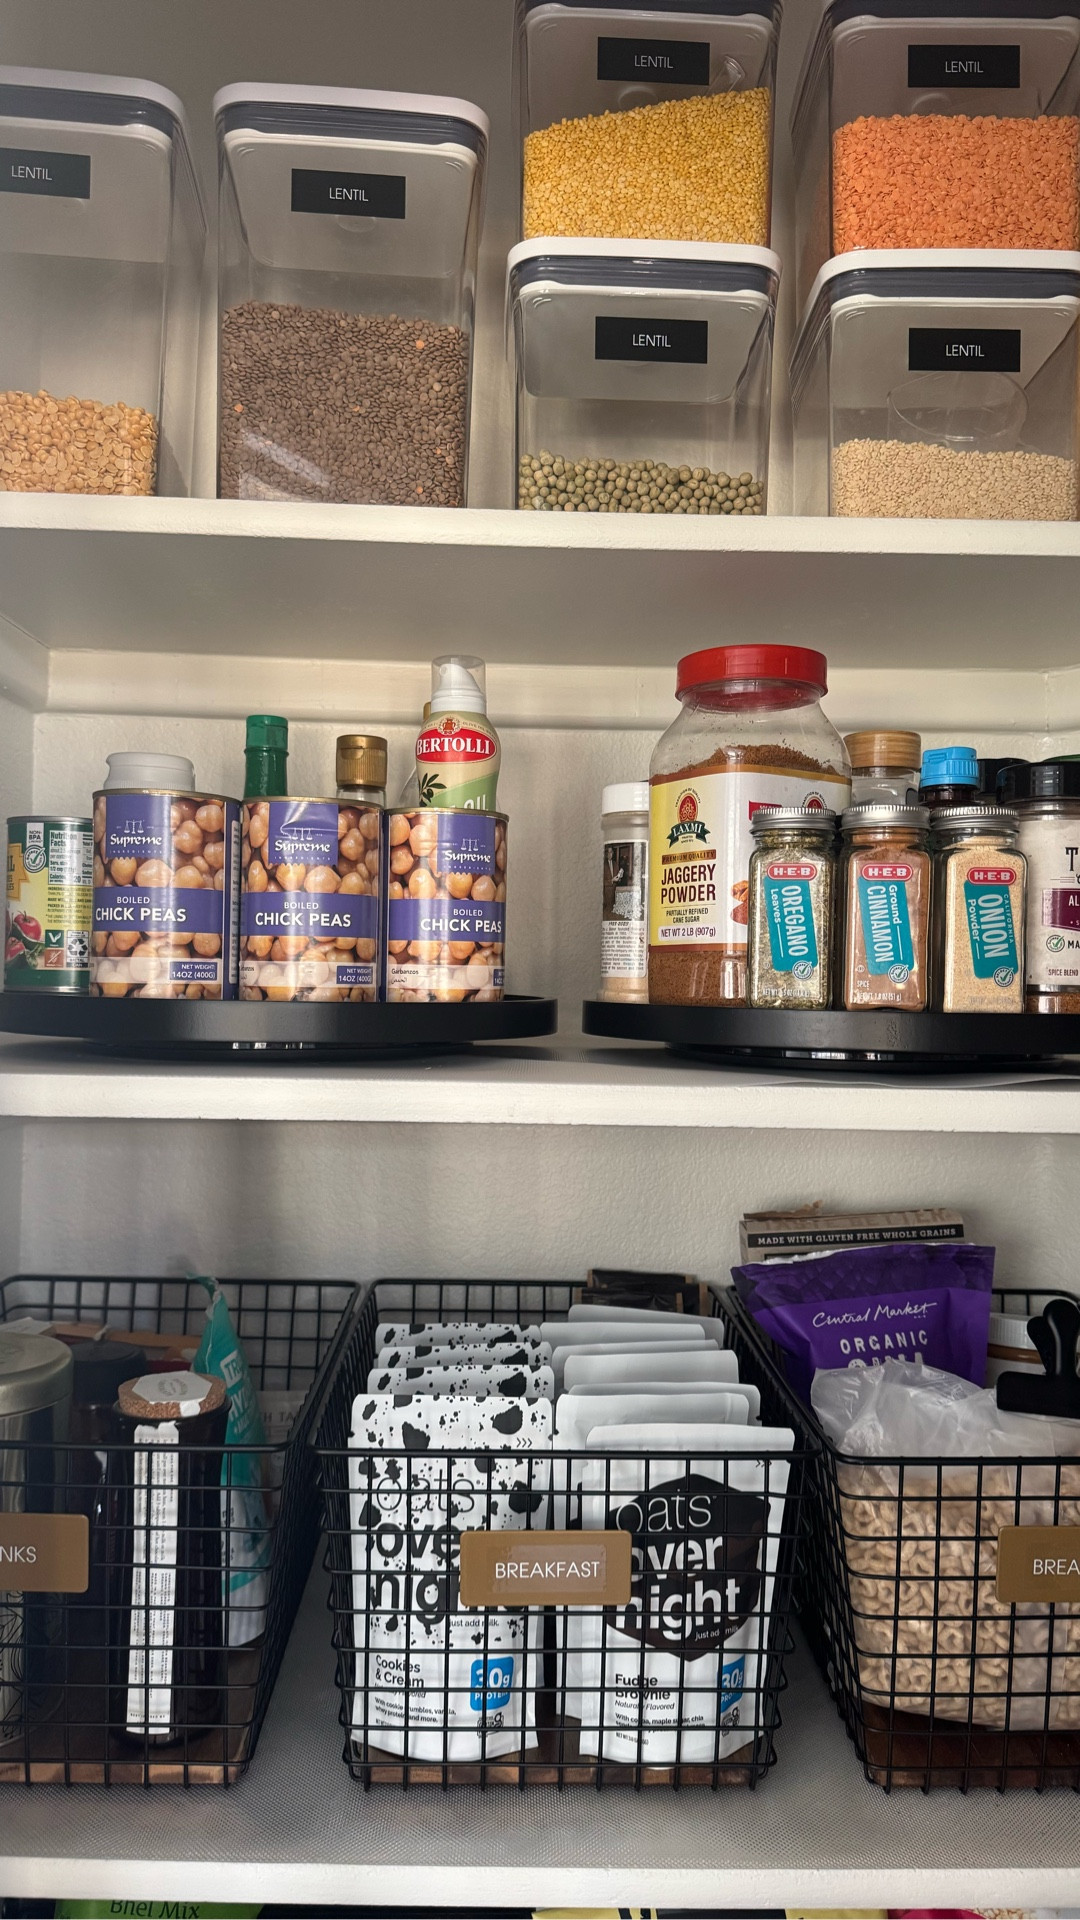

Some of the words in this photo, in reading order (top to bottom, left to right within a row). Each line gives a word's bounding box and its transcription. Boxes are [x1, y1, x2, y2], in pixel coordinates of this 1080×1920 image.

[634, 54, 674, 70] LENTIL
[945, 60, 984, 74] LENTIL
[11, 165, 53, 181] LENTIL
[328, 187, 369, 202] LENTIL
[632, 333, 672, 349] LENTIL
[945, 344, 985, 358] LENTIL
[416, 737, 490, 757] BERTOLLI
[672, 822, 703, 838] LAXMI
[110, 833, 163, 848] Supreme
[274, 839, 331, 854] Supreme
[443, 849, 492, 864] Supreme
[662, 853, 688, 864] PREMIUM
[688, 850, 716, 861] QUALITY
[661, 863, 717, 886] JAGGERY
[116, 896, 151, 905] BOILED
[661, 883, 717, 905] POWDER
[283, 901, 320, 911] BOILED
[453, 908, 483, 917] BOILED
[688, 907, 709, 915] REFINED
[770, 888, 780, 925] Leaves
[888, 884, 903, 925] Ground
[95, 907, 135, 922] CHICK
[140, 907, 187, 922] PEAS
[255, 912, 304, 927] CHICK
[309, 912, 352, 928] PEAS
[684, 915, 700, 923] SUGAR
[781, 884, 809, 957] OREGANO
[968, 899, 981, 942] Powder
[1003, 893, 1014, 944] CALIFORNIA
[420, 918, 471, 933] CHICK
[474, 919, 502, 934] PEAS
[866, 884, 895, 963] CINNAMON
[978, 893, 1010, 958] ONION
[661, 928, 672, 938] NET
[671, 927, 681, 937] WT
[681, 928, 686, 937] 2
[686, 927, 694, 937] LB
[695, 926, 717, 938] (907g)
[172, 971, 193, 979] 14OZ
[193, 971, 216, 980] (400G)
[338, 974, 356, 983] 14OZ
[1048, 968, 1063, 976] SPICE
[1063, 969, 1079, 977] BLEND
[856, 980, 870, 988] SPICE
[757, 1237, 785, 1245] MADE
[786, 1235, 813, 1244] WITH
[815, 1233, 854, 1243] GLUTEN
[856, 1232, 880, 1241] FREE
[882, 1230, 918, 1239] WHOLE
[919, 1228, 957, 1237] GRAINS
[812, 1307, 871, 1328] Central
[873, 1301, 938, 1321] Market
[839, 1329, 928, 1355] ORGANIC
[376, 1468, 475, 1513] oats
[615, 1488, 712, 1533] oats
[376, 1522, 486, 1560] ove
[494, 1561, 601, 1580] BREAKFAST
[1033, 1558, 1080, 1576] BREA
[615, 1578, 741, 1641] night
[465, 1618, 480, 1628] add
[695, 1631, 709, 1641] just
[710, 1628, 721, 1638] ad
[375, 1654, 421, 1673] Cookies
[375, 1669, 382, 1681] &
[384, 1672, 425, 1689] Crem
[475, 1666, 511, 1689] 30g
[385, 1701, 404, 1712] cookie
[646, 1702, 676, 1710] Flavored
[420, 1715, 438, 1723] more.
[615, 1712, 630, 1722] With
[651, 1717, 672, 1726] maple
[691, 1714, 704, 1722] chia
[158, 1901, 201, 1919] Mix
